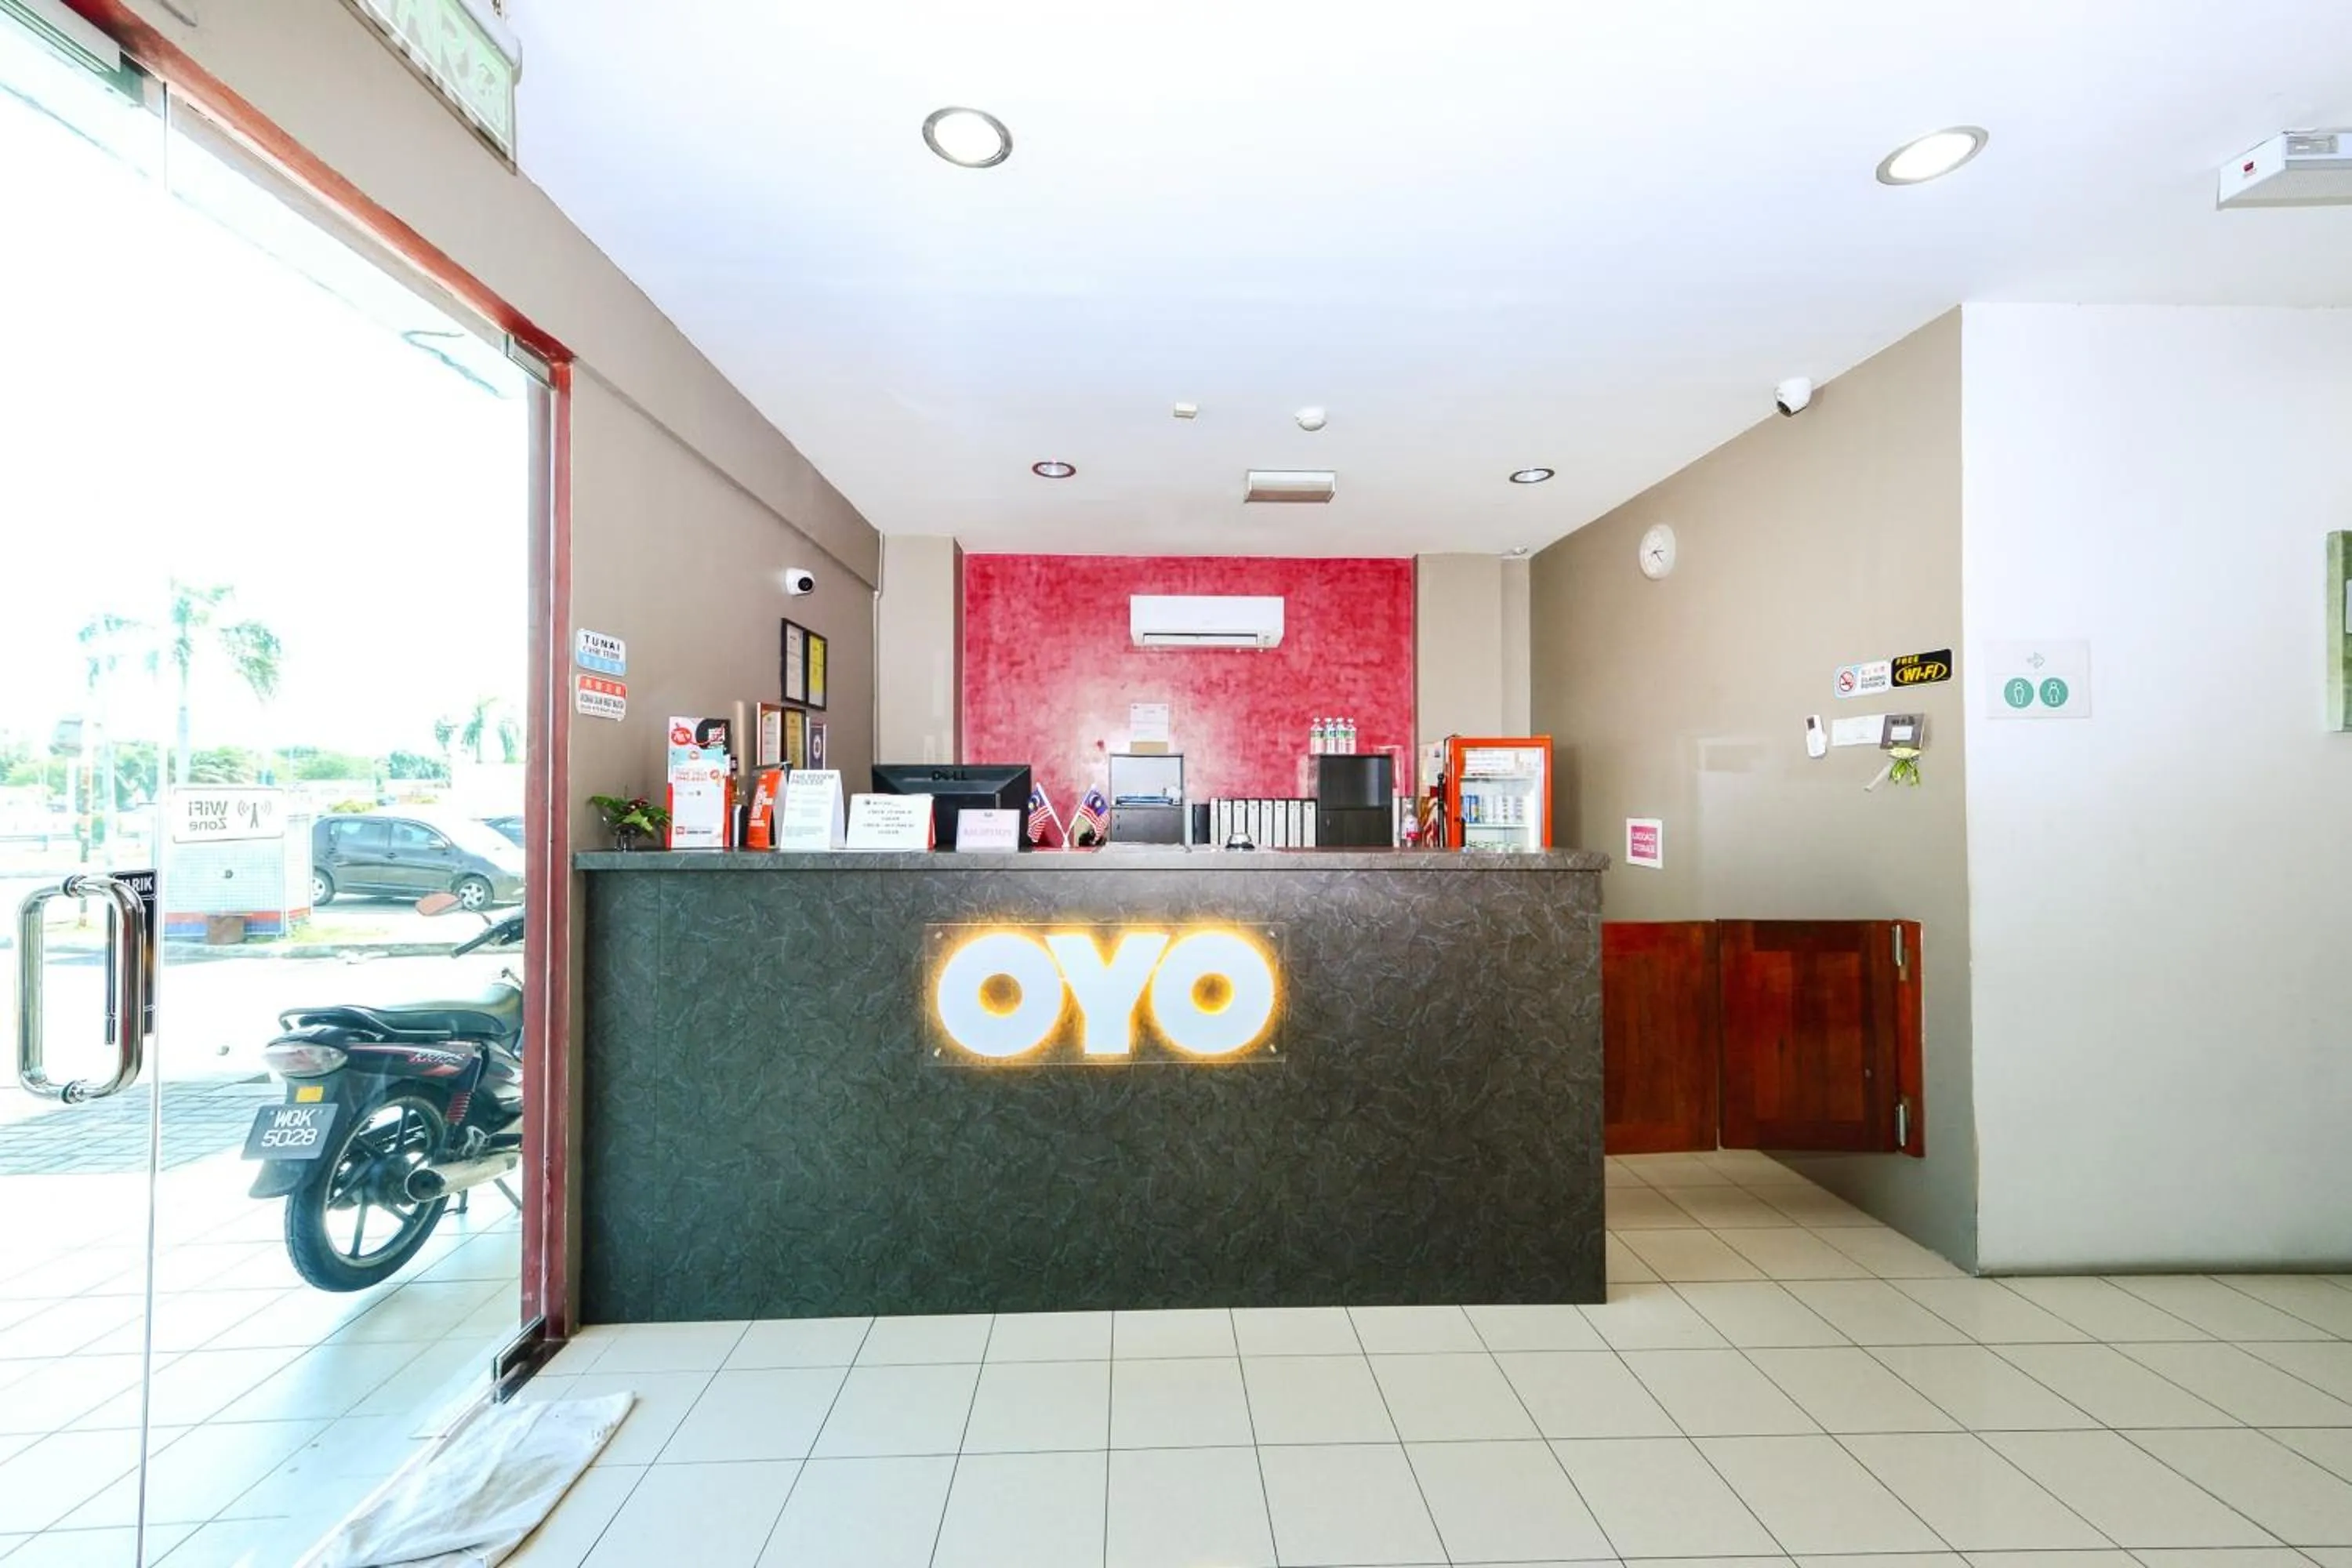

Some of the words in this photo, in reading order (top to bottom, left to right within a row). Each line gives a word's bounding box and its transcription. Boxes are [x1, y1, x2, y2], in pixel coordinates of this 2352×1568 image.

[583, 634, 620, 652] TUNAI
[1895, 655, 1919, 666] FREE
[1903, 664, 1939, 681] WI-FI
[931, 769, 969, 782] DELL
[937, 931, 1275, 1056] OYO
[274, 1109, 316, 1127] WQK
[261, 1129, 318, 1147] 5028
